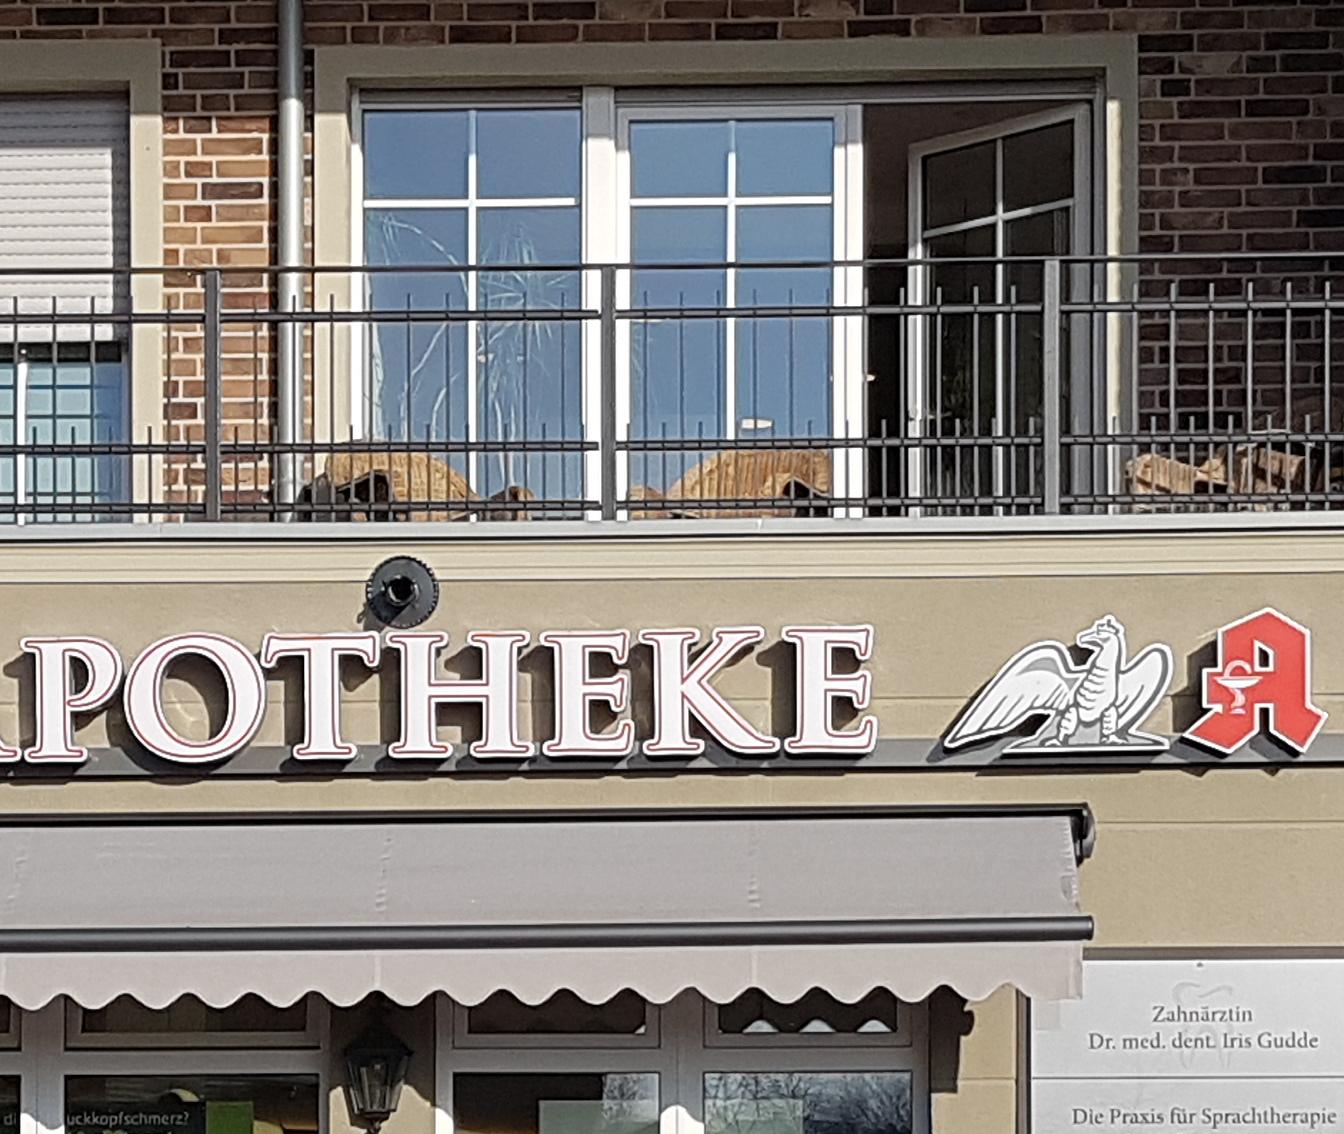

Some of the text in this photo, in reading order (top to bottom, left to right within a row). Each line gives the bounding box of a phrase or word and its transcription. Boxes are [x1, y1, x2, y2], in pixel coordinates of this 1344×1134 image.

[1152, 1005, 1253, 1023] Zahnärztin
[1089, 1033, 1319, 1050] Dr. med. dent. Iris Gudde
[1073, 1108, 1337, 1129] Die Praxis für Sprachtherapie
